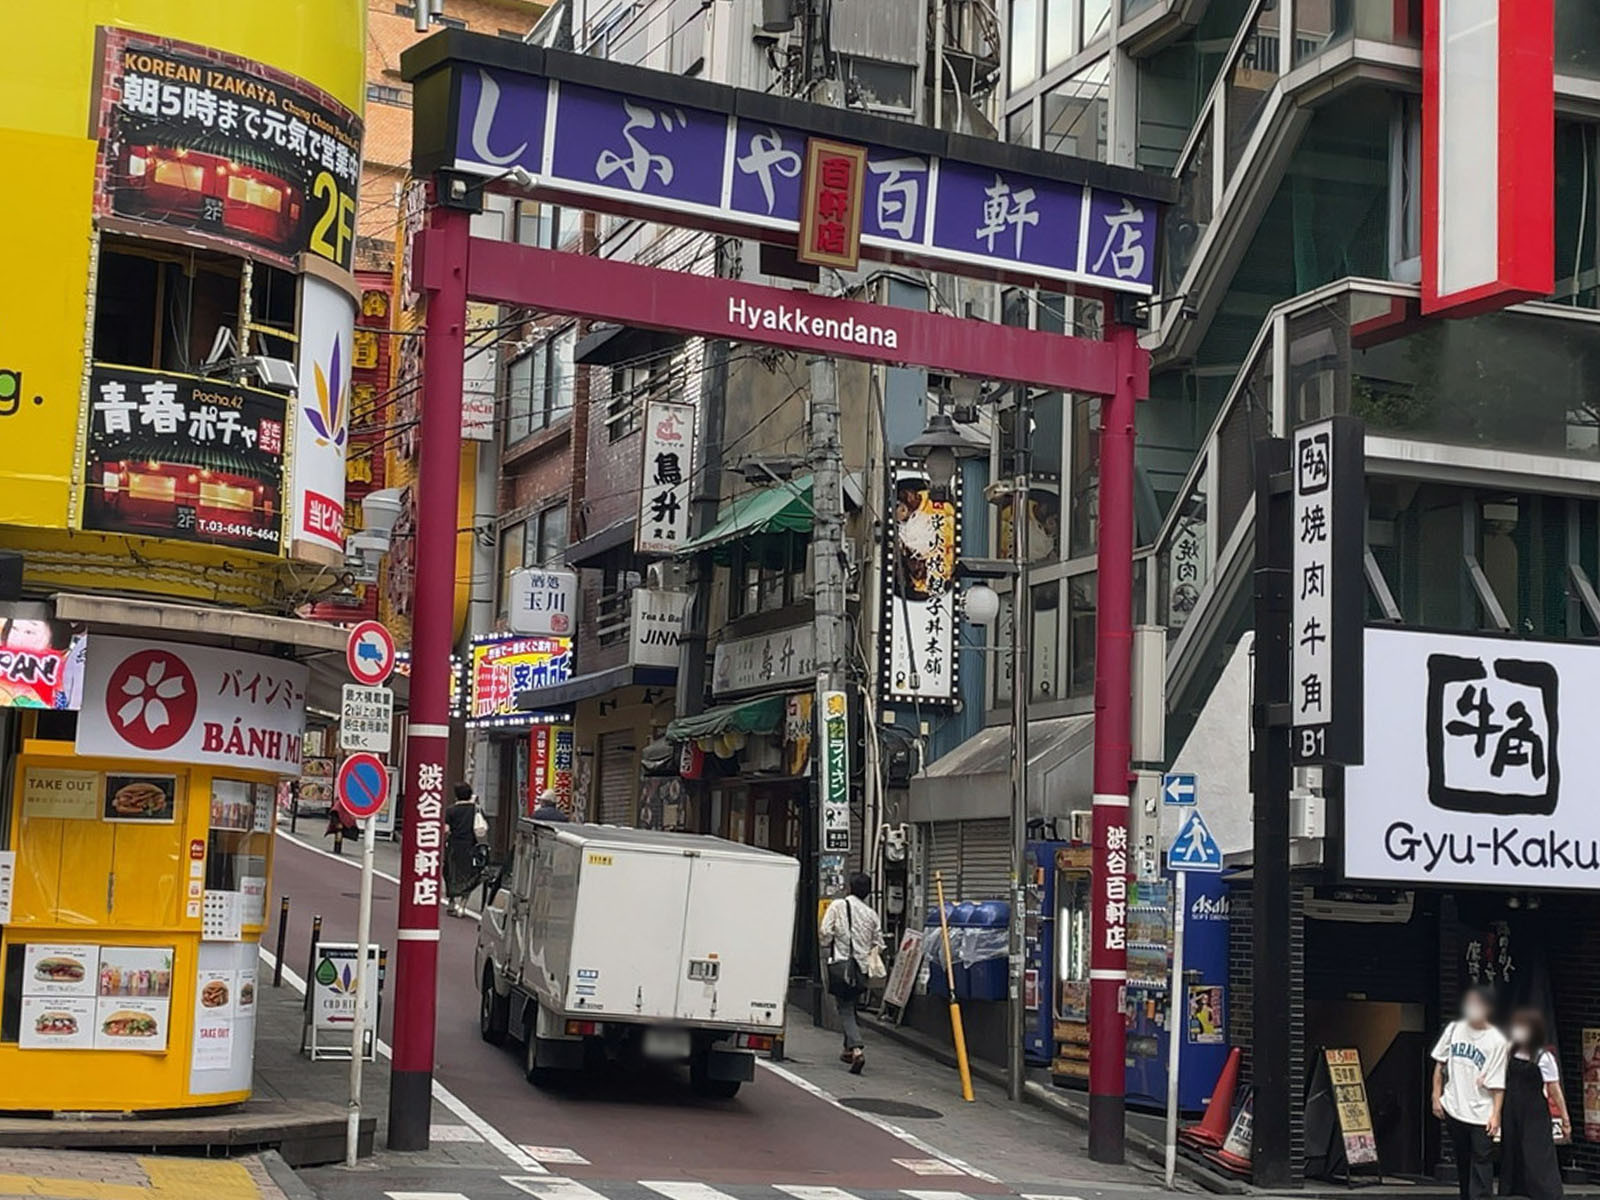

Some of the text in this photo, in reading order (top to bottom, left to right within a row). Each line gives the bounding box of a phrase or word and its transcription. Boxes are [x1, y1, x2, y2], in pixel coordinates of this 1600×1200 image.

[125, 53, 201, 85] KOREAN
[206, 71, 278, 106] IZAKAYA
[123, 74, 359, 186] 朝5時まで元気で営業中
[470, 67, 1147, 280] しぶや百軒店
[204, 206, 222, 221] 2F
[309, 171, 355, 275] 2F
[817, 157, 851, 255] 百軒店
[727, 297, 899, 350] Hyakkendana
[94, 381, 258, 449] 青春ポチャ
[192, 389, 243, 409] Pocha.42
[651, 452, 682, 525] 鳥升
[199, 519, 280, 542] T.03-6416-4642
[523, 592, 566, 613] 玉川
[530, 575, 560, 589] 酒処
[1300, 504, 1327, 714] 焼肉牛角
[218, 669, 304, 710] バインミー
[201, 716, 282, 759] BÁNH
[1301, 728, 1326, 757] B1
[28, 778, 94, 791] TAKE OUT
[830, 739, 846, 798] ライオン
[393, 763, 443, 906] 渋谷百軒店
[1384, 821, 1600, 873] Gyu-Kaku
[1105, 826, 1128, 950] 渋谷百軒店
[200, 1028, 230, 1038] TAKE OUT
